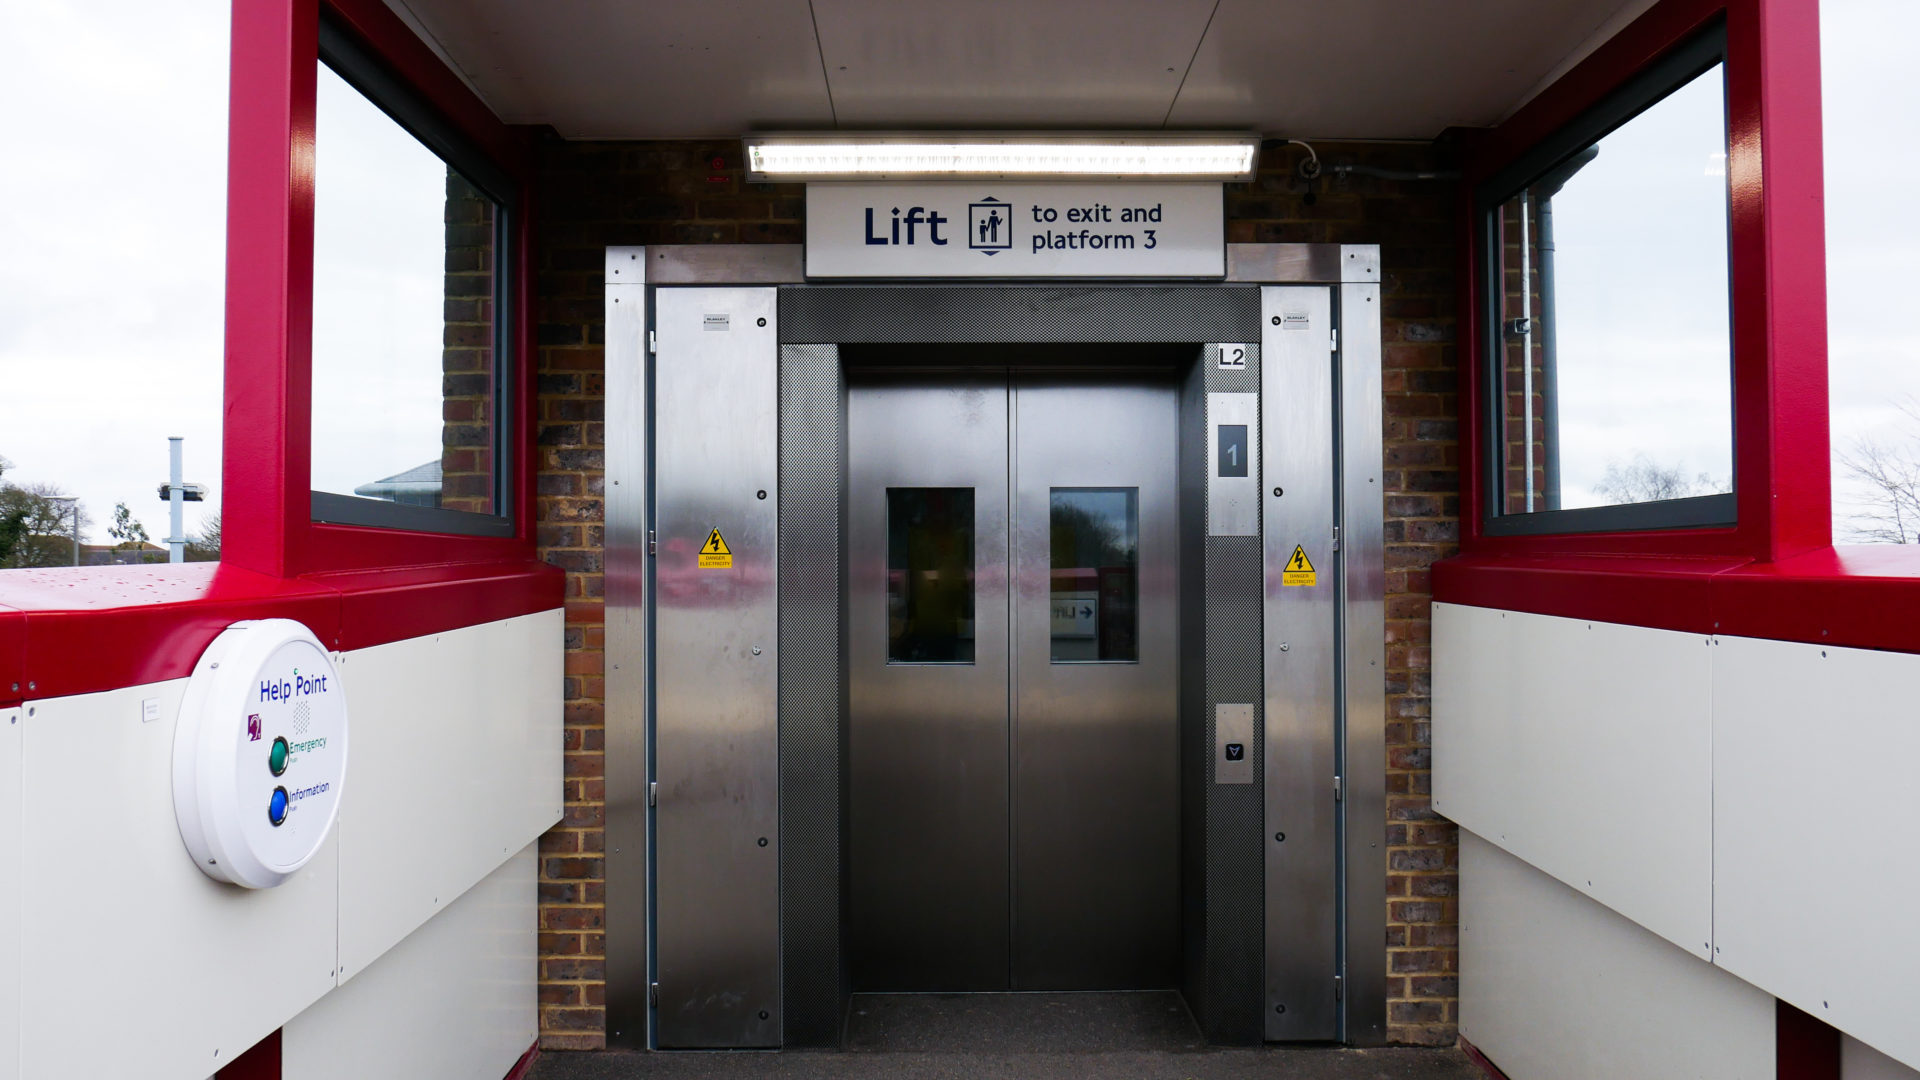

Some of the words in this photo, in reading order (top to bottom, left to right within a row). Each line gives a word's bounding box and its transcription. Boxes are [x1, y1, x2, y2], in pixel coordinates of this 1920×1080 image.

[1032, 204, 1058, 223] to
[1067, 203, 1111, 223] exit
[1121, 203, 1162, 223] and
[865, 206, 948, 245] Lift
[1032, 229, 1135, 254] platform
[1143, 230, 1158, 249] 3
[1219, 348, 1245, 366] L2
[1227, 443, 1238, 467] 1
[260, 678, 292, 704] Help
[296, 674, 328, 697] Point
[289, 736, 328, 755] Emergency
[289, 781, 330, 803] Information
